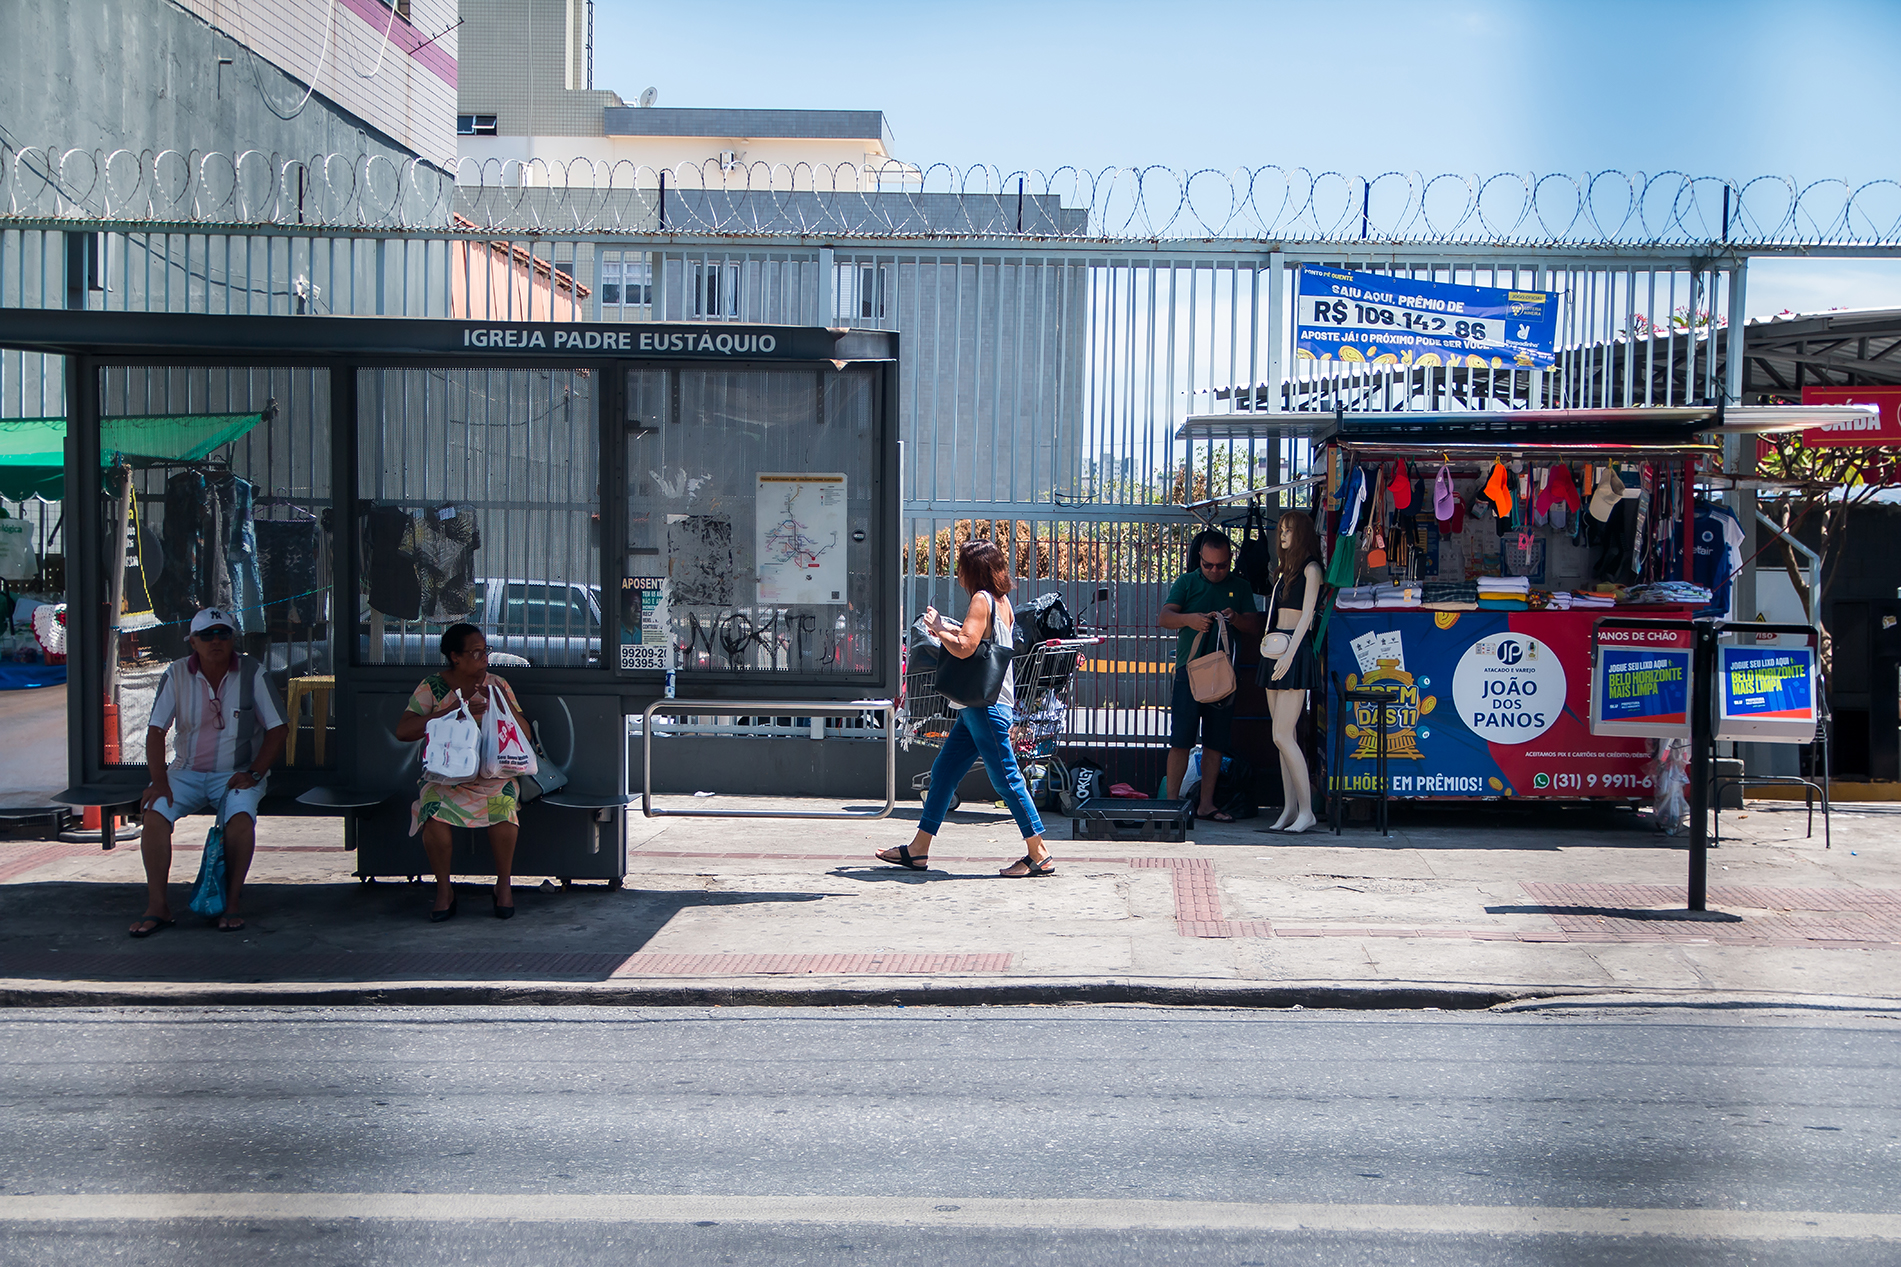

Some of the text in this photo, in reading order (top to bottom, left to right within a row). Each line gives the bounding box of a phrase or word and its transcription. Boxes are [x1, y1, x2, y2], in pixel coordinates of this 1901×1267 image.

[1331, 284, 1361, 298] SAIU
[1398, 294, 1446, 311] PRÊMIO
[1446, 301, 1465, 313] DE
[1314, 299, 1348, 325] R$
[463, 328, 777, 355] IGREJA PADRE EUSTÁQUIO
[1300, 330, 1340, 342] APOSTE
[1341, 331, 1359, 342] JÁ!
[1360, 333, 1368, 342] O
[1369, 332, 1414, 344] PRÓXIMO
[1415, 336, 1442, 347] PODE
[1442, 339, 1462, 349] SER
[1820, 398, 1882, 431] ÍDA
[0, 524, 23, 534] lógica
[1632, 632, 1645, 641] DE
[1647, 630, 1678, 641] CHÃO
[621, 659, 667, 668] 99395-3
[1608, 659, 1668, 673] JOGUE SEU LIXO AQUI
[1730, 657, 1790, 670] JOGUE SEU LIXO AQUI
[1608, 667, 1683, 687] BELO HORIZONTE
[1731, 664, 1806, 683] BELO HORIZONTE
[1481, 676, 1538, 699] JOÃO
[1608, 682, 1659, 699] MAIS LIMPA
[1732, 679, 1783, 695] MAIS LIMPA
[1492, 699, 1522, 709] DOS
[1401, 709, 1417, 725] 11
[1473, 712, 1545, 728] PANOS
[1572, 750, 1597, 758] CARTÕES
[1329, 772, 1483, 791] MLHÕES EM PRÊMIOS!
[1553, 773, 1654, 790] (31) 9 9911-6
